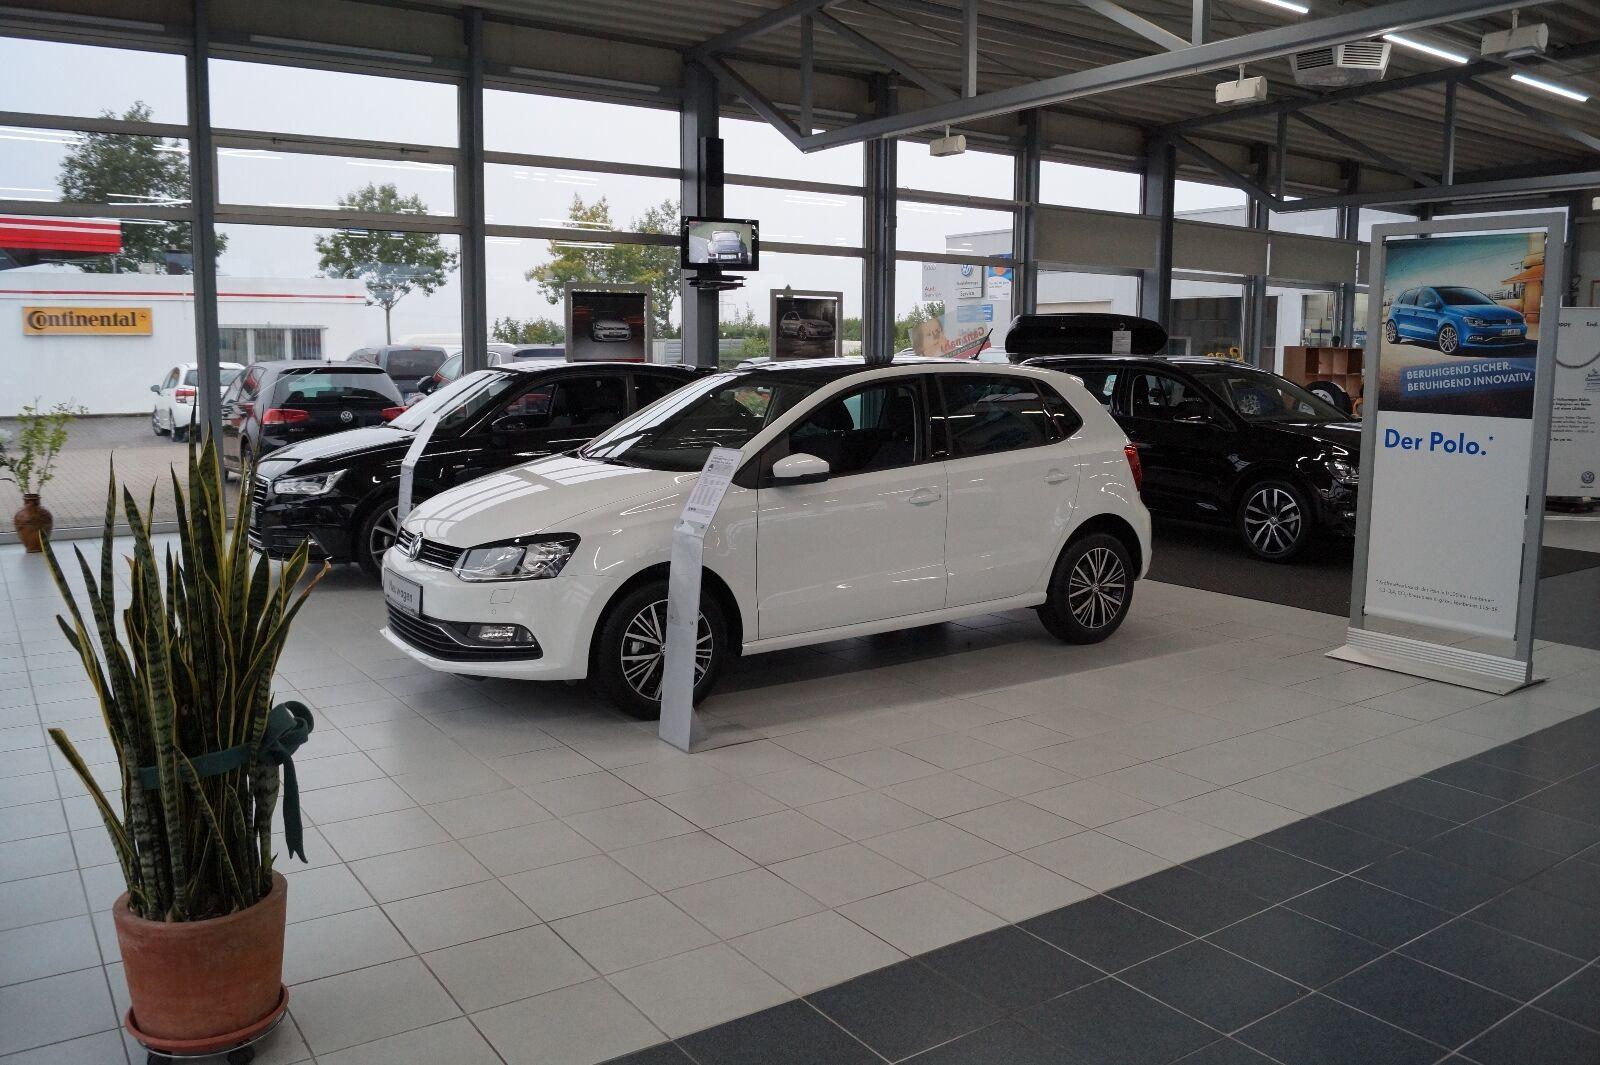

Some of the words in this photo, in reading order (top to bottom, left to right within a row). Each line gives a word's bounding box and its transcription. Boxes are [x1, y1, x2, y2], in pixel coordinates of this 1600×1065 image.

[28, 311, 136, 330] Continental
[1407, 365, 1471, 380] BERUHIGEND
[1473, 361, 1512, 374] SICHER.
[1407, 378, 1471, 392] BERUHIGEND
[1473, 372, 1533, 386] INNOVATIV.
[1384, 428, 1423, 450] Der
